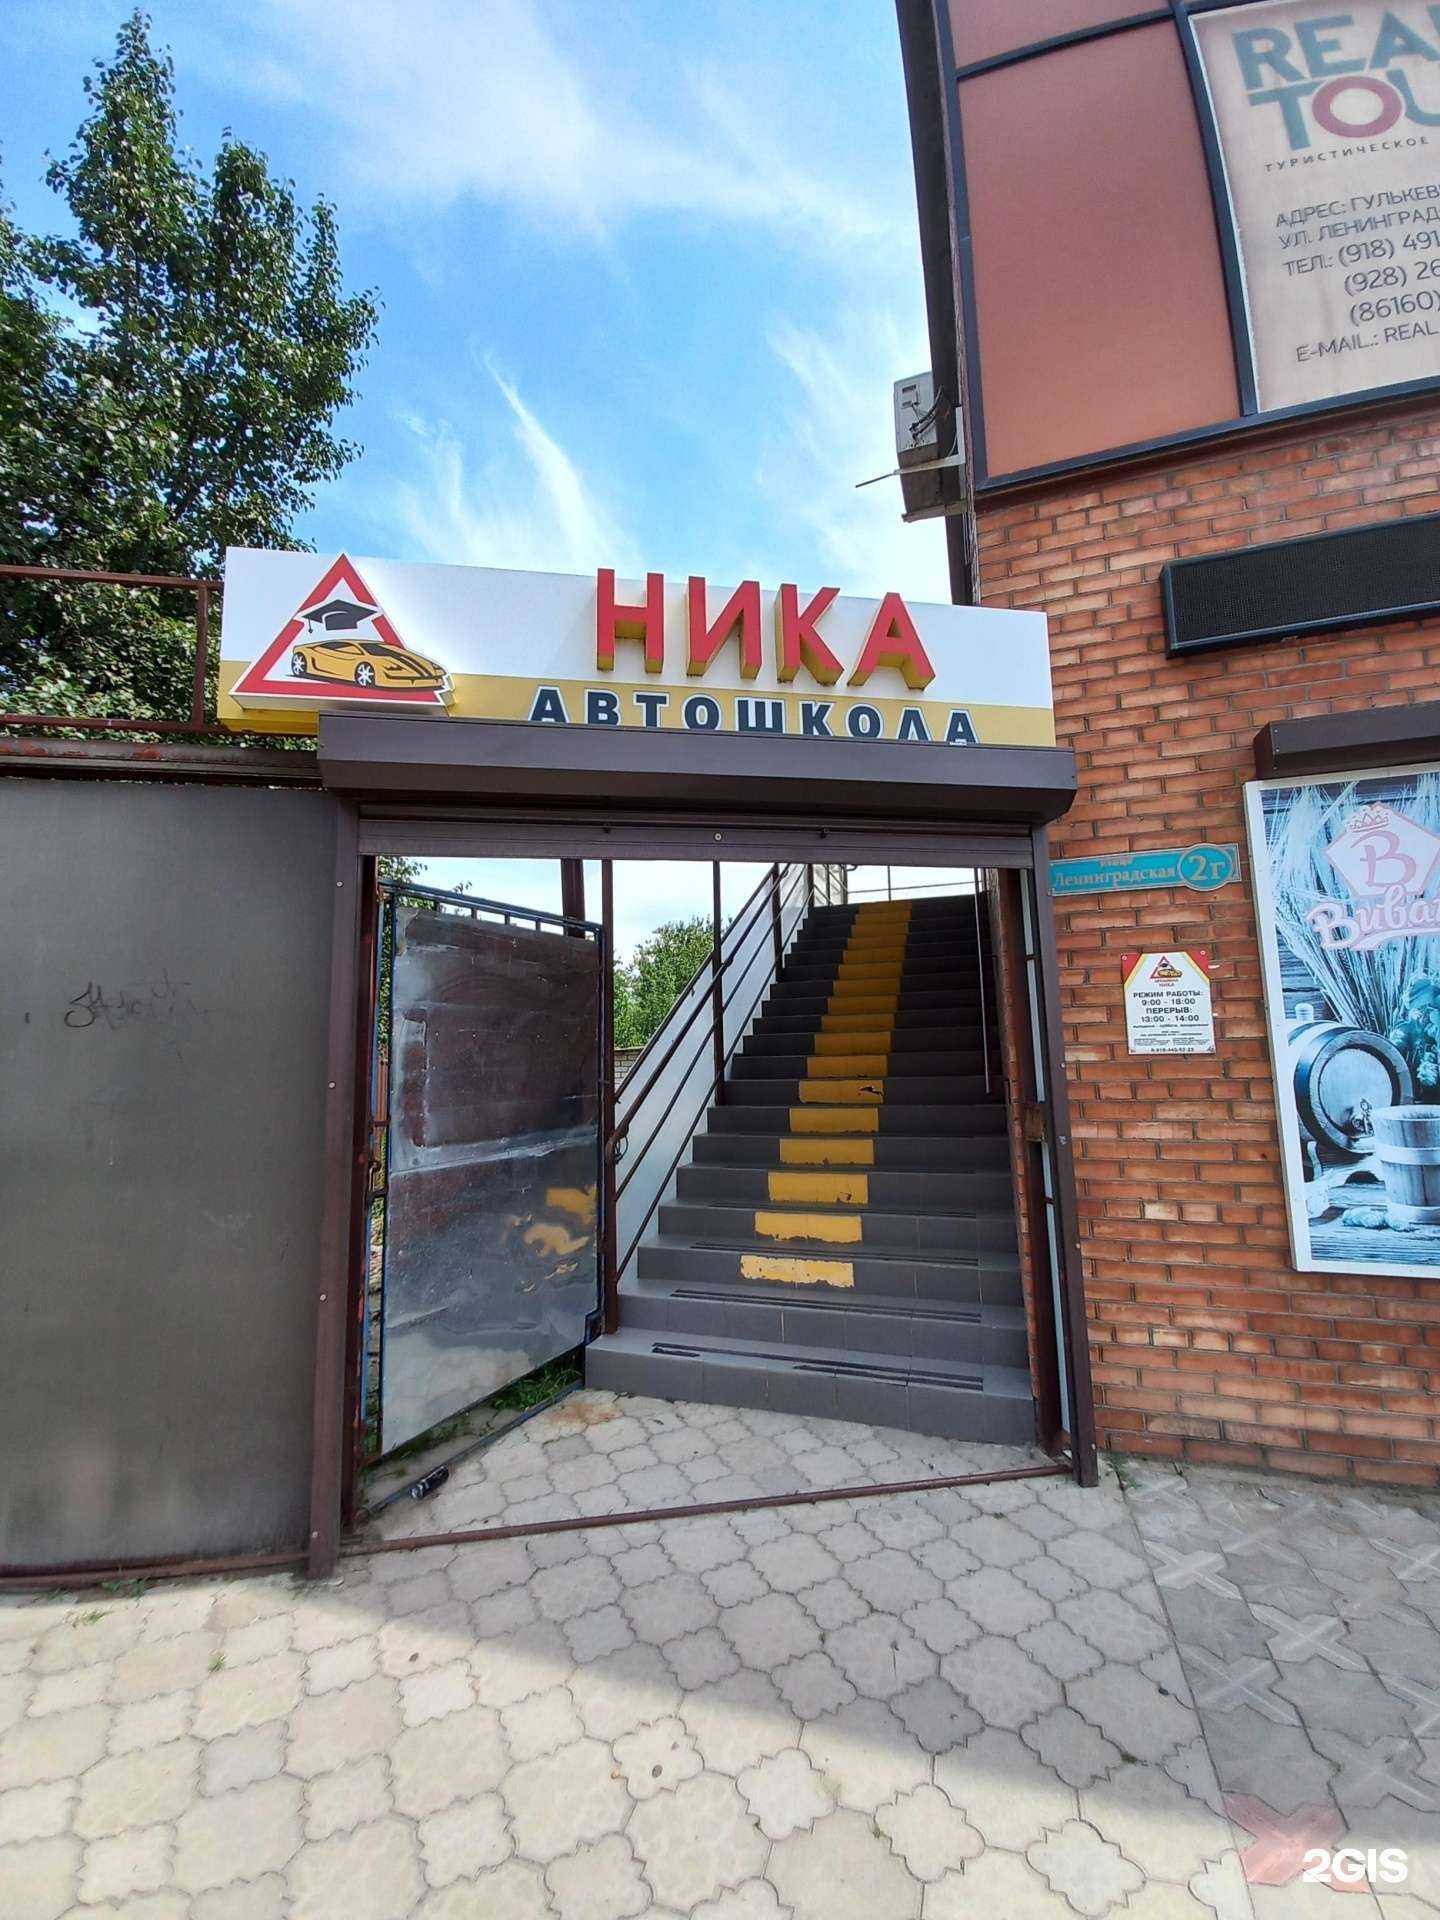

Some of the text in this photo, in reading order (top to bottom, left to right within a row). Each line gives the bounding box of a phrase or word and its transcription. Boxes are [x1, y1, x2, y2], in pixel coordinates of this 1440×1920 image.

[1232, 3, 1440, 91] REA
[1264, 135, 1430, 173] ТУРИСТИЧЕСКОЕ
[1276, 184, 1440, 229] АДРЕС: ГУЛЬКЕВ
[1279, 230, 1314, 250] УЛ.
[1283, 255, 1334, 277] ТЕЛ.:
[1338, 237, 1395, 267] (918)
[1344, 265, 1408, 297] (928)
[596, 568, 935, 692] НИКА
[528, 686, 979, 745] АВТОШКОЛА
[1055, 867, 1176, 888] Ленинградская
[1307, 886, 1440, 949] Вива
[1146, 1007, 1193, 1015] ПЕРЕРЫВ:
[1175, 1014, 1200, 1022] 14:00
